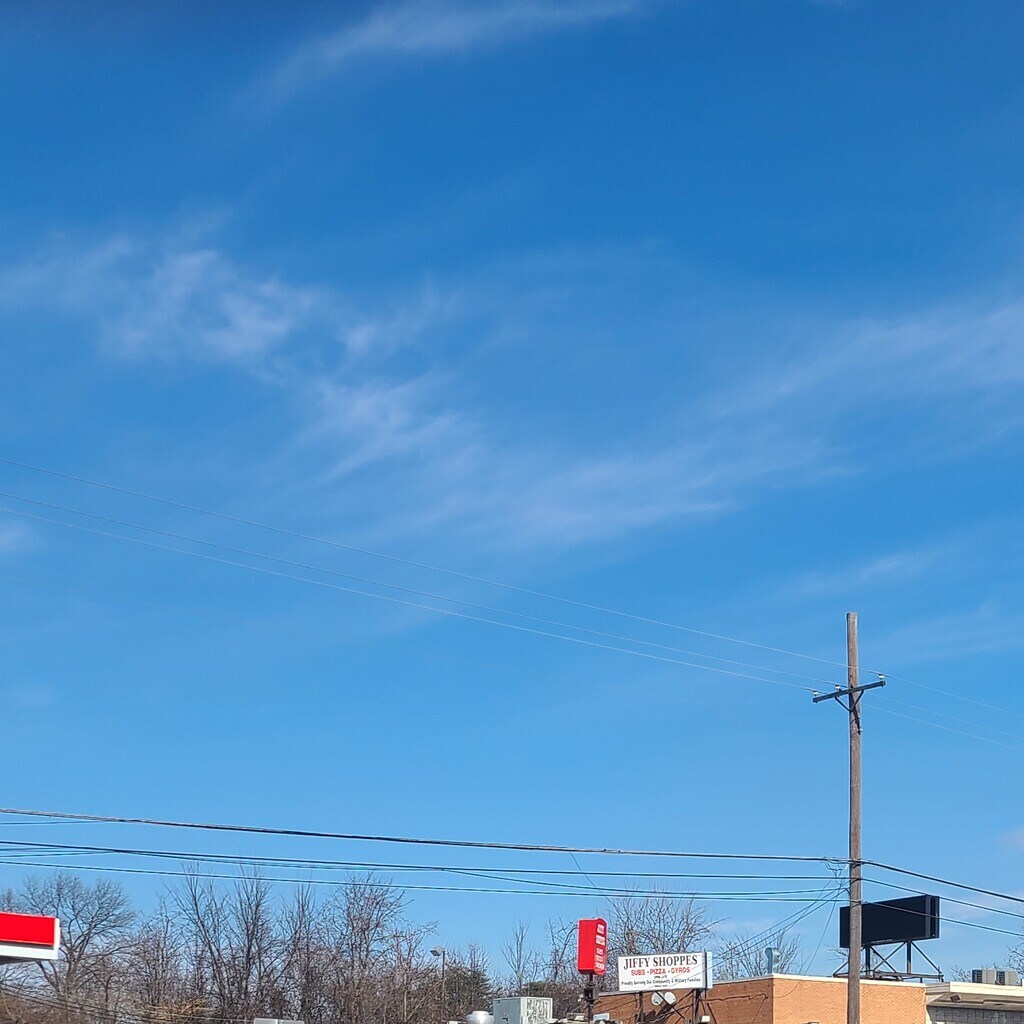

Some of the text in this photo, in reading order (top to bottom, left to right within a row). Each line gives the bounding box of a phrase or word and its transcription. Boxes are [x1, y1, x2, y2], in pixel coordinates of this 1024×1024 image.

[624, 954, 698, 970] JIFFY SHOPPES
[631, 969, 645, 977] SUBS
[650, 968, 667, 976] PIZZA
